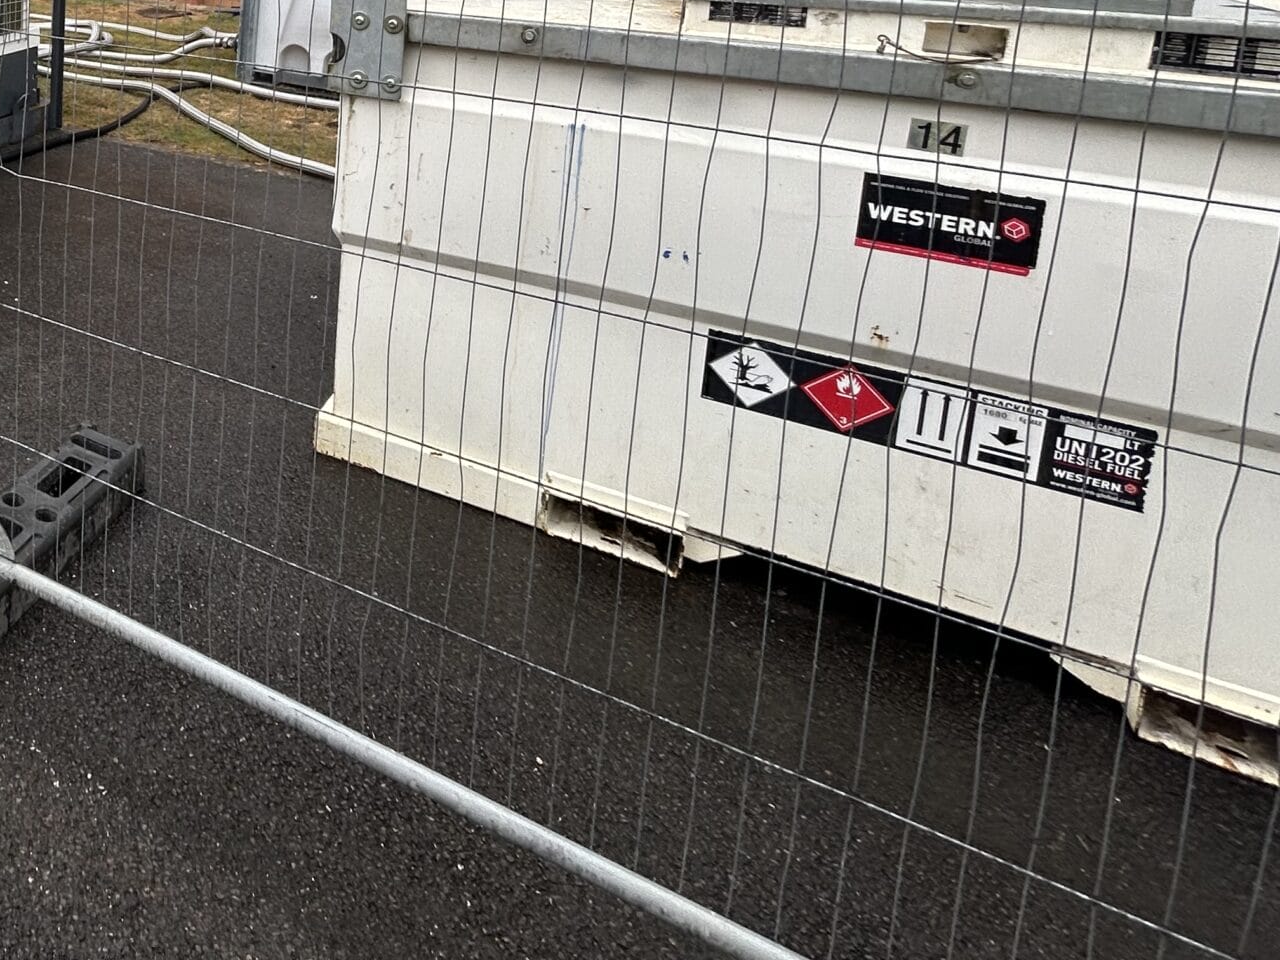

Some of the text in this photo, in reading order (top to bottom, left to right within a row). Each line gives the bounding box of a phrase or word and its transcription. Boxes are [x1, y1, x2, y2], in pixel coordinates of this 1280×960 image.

[917, 122, 962, 154] 14
[954, 234, 993, 247] GLOBAL
[839, 416, 847, 424] 3
[1125, 439, 1140, 451] LT
[1053, 450, 1142, 480] DIESEL FUEL
